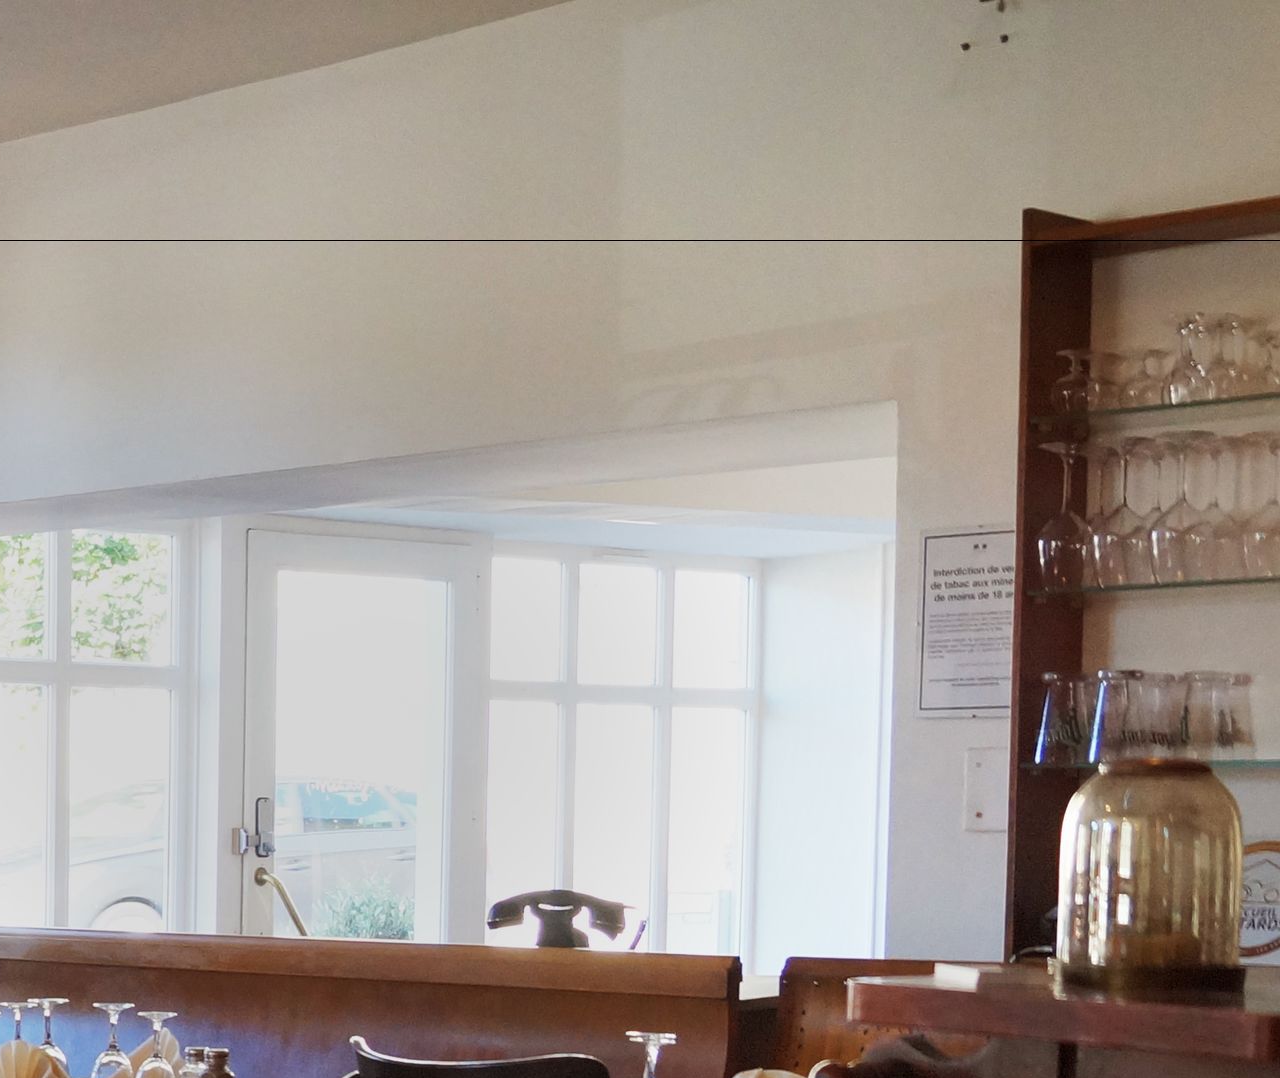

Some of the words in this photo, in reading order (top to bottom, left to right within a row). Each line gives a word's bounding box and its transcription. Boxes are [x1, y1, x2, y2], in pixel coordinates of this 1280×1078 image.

[933, 567, 985, 577] Interdiction
[987, 565, 999, 574] de
[930, 582, 942, 590] de
[944, 580, 969, 589] tabac
[934, 594, 945, 602] de
[947, 593, 975, 601] moins
[977, 591, 989, 600] de
[993, 590, 1002, 599] 18
